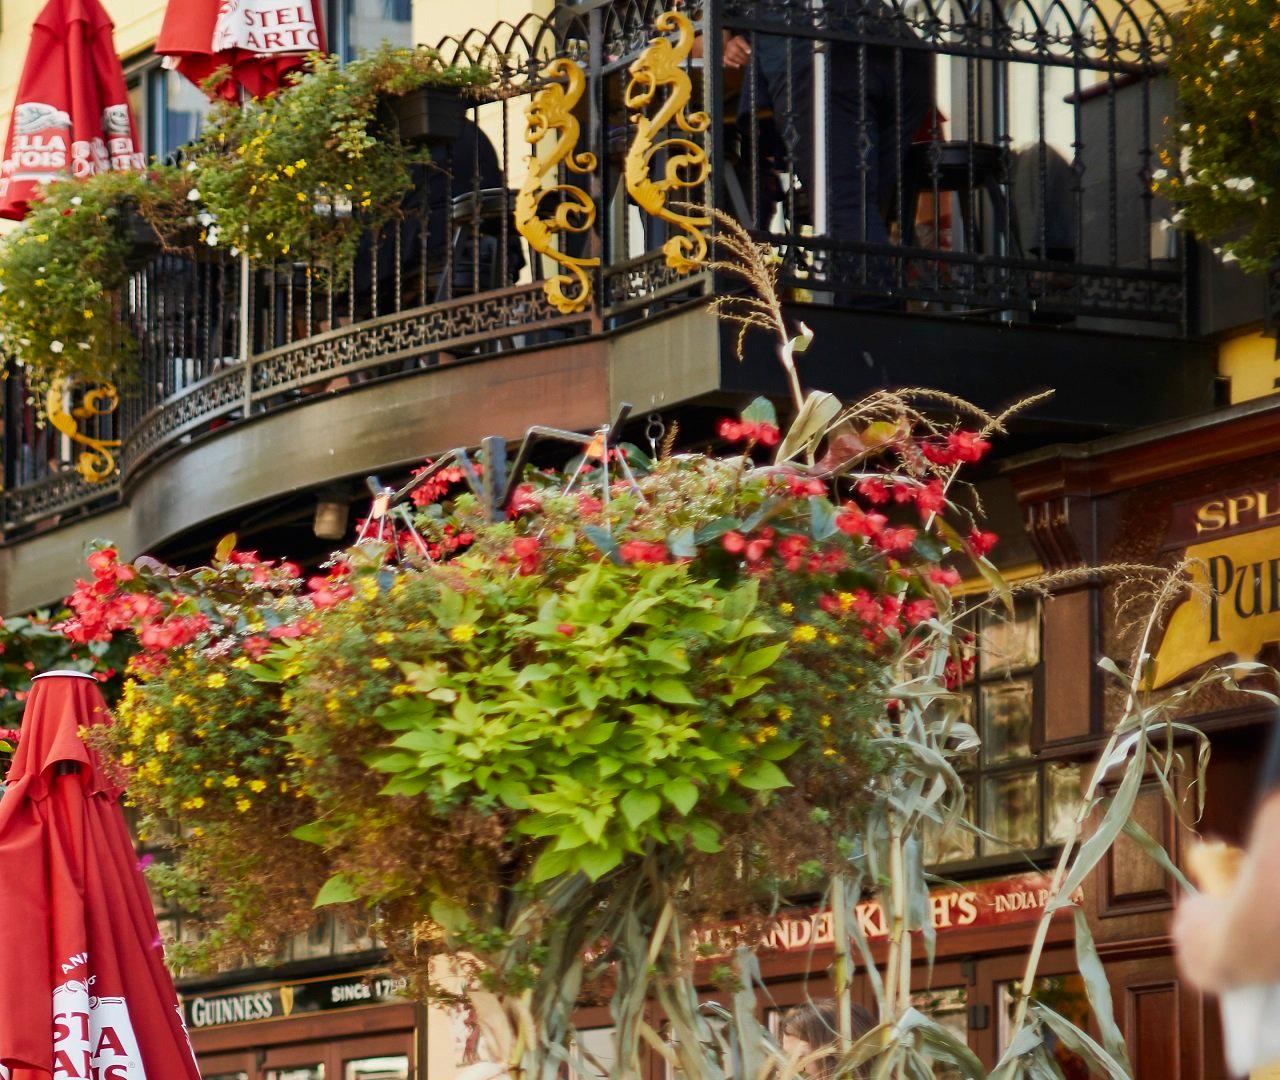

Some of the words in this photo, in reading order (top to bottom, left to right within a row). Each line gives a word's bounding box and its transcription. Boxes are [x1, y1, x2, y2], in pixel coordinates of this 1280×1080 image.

[244, 7, 313, 27] STEL
[1196, 491, 1280, 535] SPL
[855, 891, 978, 938] KH'S
[191, 991, 273, 1028] GUINNESS
